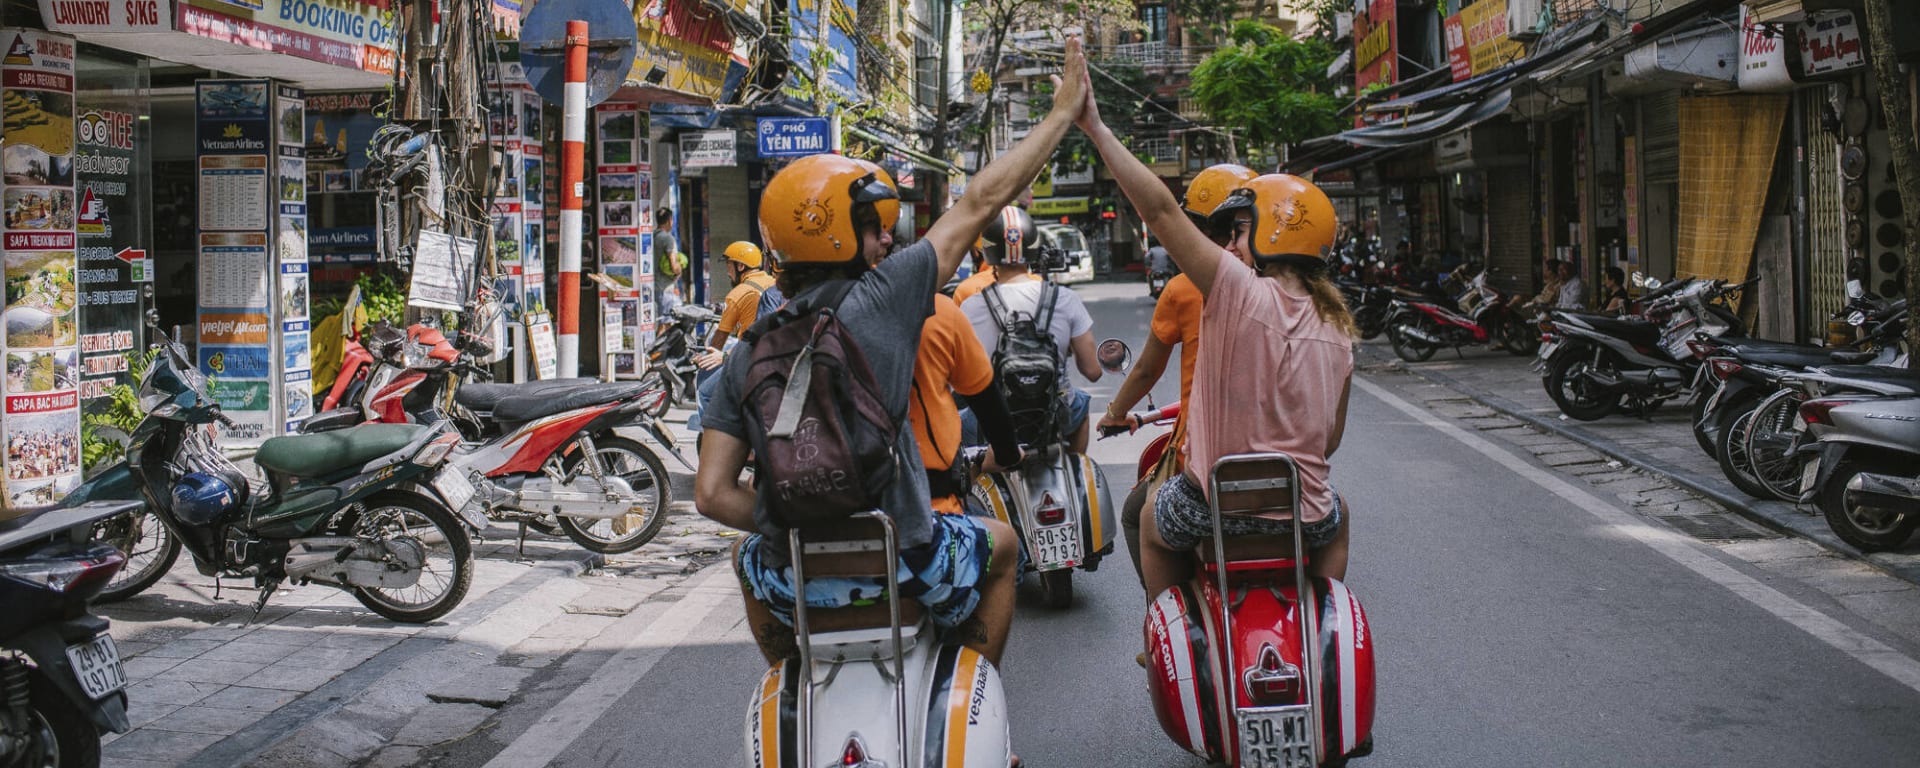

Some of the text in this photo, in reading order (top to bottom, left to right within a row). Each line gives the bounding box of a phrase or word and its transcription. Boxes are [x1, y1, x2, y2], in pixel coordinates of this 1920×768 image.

[52, 0, 158, 26] LAUNDRY $/KG
[279, 0, 364, 38] BOOKING
[18, 72, 36, 85] SAPA
[339, 94, 372, 110] BAY
[782, 121, 806, 133] PHỐ
[203, 138, 265, 149] Vietnam Airlines
[766, 132, 823, 151] YÊN THÁI
[10, 234, 29, 247] SAPA
[329, 232, 369, 244] Airlines
[92, 291, 109, 304] BUS
[82, 334, 113, 352] SERVICE
[84, 355, 106, 375] TRAIN
[225, 354, 262, 370] THAI
[13, 398, 35, 411] SAPA
[224, 431, 260, 440] AIRLINES
[1037, 526, 1076, 546] 50-S2
[1041, 543, 1078, 563] 2792
[83, 661, 125, 695] 497.70
